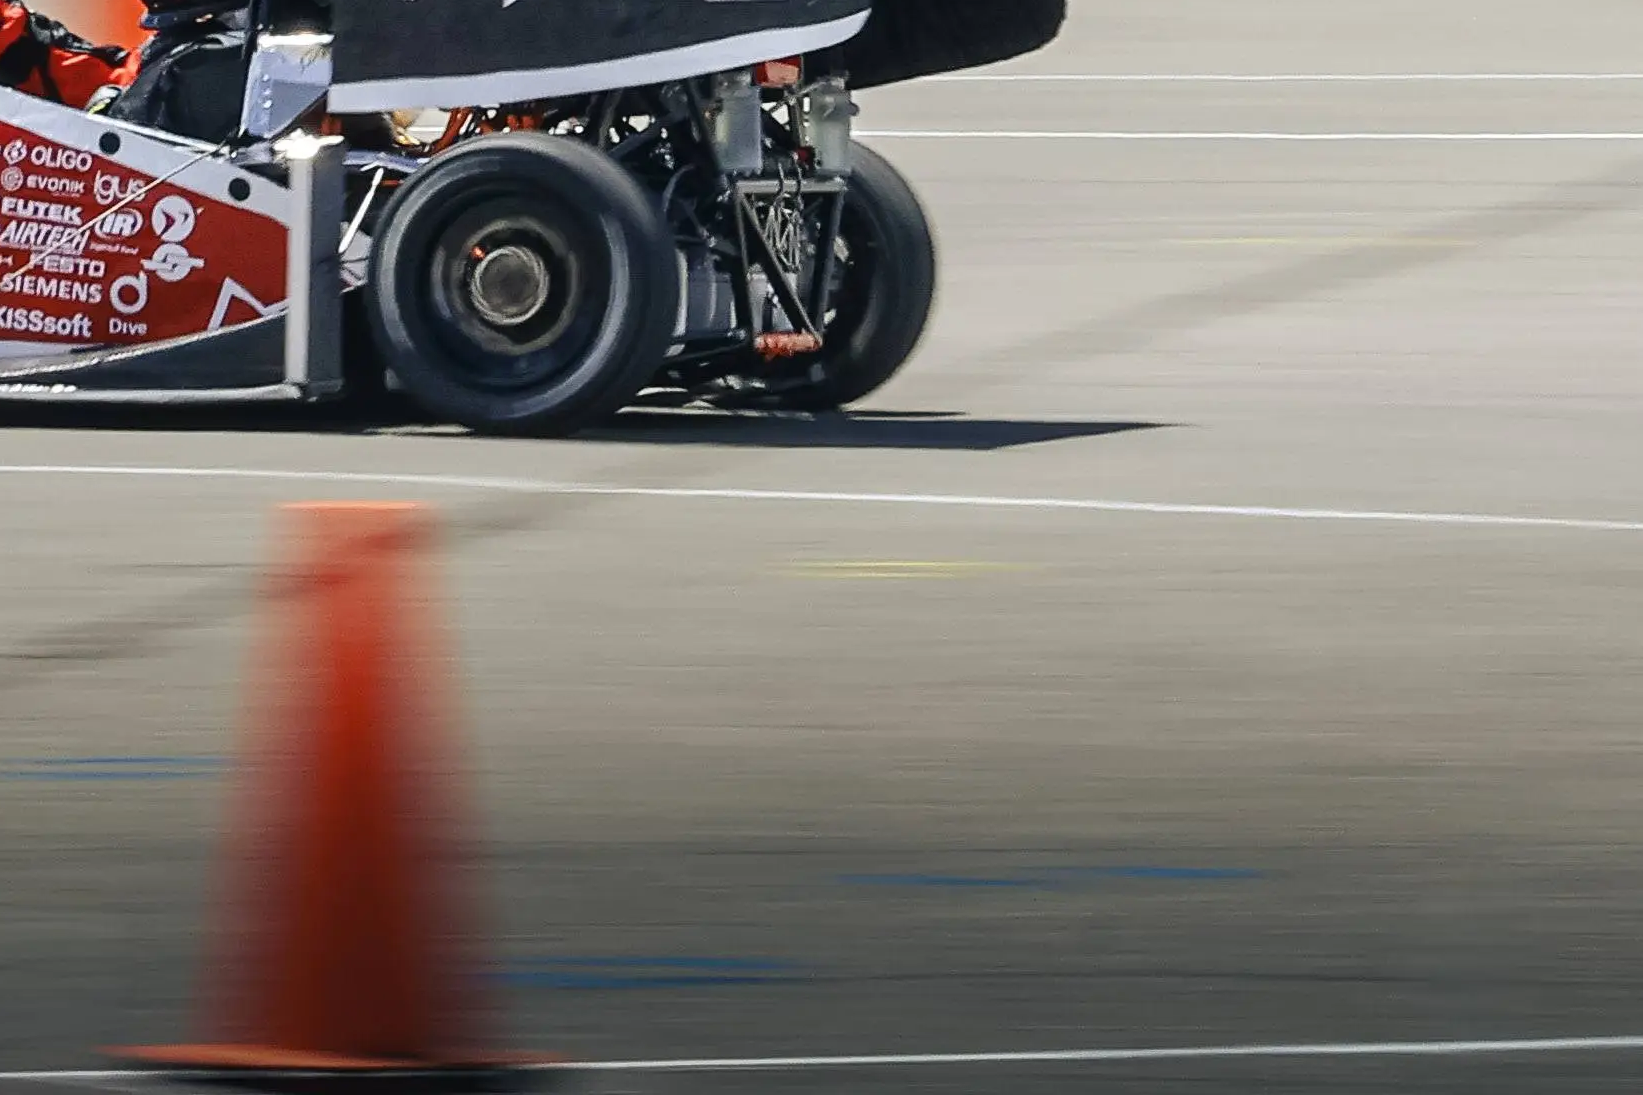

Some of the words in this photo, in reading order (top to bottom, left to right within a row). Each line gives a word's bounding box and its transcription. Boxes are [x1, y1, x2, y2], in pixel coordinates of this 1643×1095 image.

[30, 144, 93, 172] OLIGO
[0, 273, 103, 304] SIEMENS
[108, 318, 148, 336] Dive
